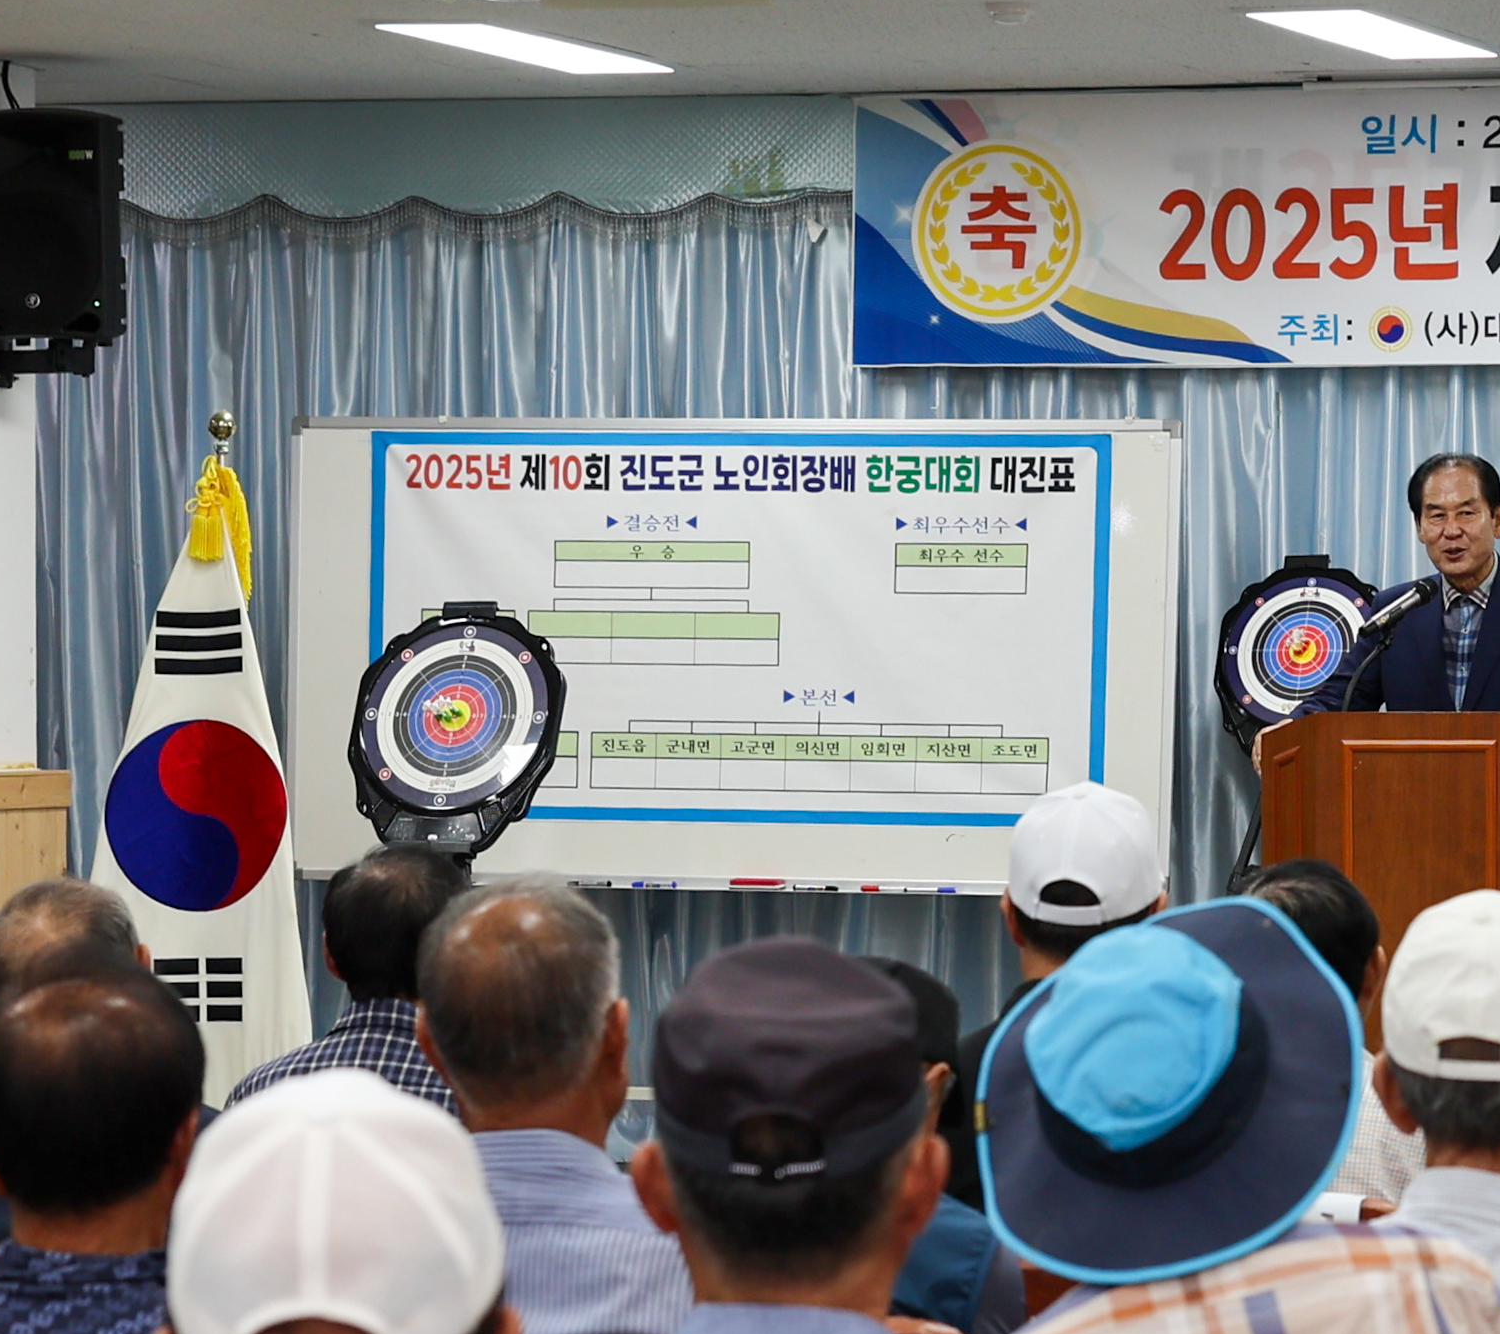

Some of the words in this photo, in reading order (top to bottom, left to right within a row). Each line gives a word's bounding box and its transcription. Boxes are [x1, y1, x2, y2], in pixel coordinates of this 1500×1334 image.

[1361, 114, 1438, 154] 일시
[961, 185, 1037, 269] 축
[1158, 181, 1459, 281] 2025년
[405, 453, 511, 491] 2025년
[519, 452, 610, 492] 제10회
[619, 454, 704, 492] 진도군
[713, 454, 856, 494] 노인회장배
[865, 454, 980, 494] 한궁대회
[989, 455, 1076, 494] 대진표
[623, 514, 680, 533] 결승전
[912, 515, 1010, 535] 최우수선수
[918, 548, 965, 563] 최우수
[972, 549, 1005, 564] 선수
[801, 688, 837, 707] 본선
[601, 737, 646, 754] 진도읍
[665, 738, 710, 755] 군내면
[730, 739, 775, 756] 고군면
[795, 740, 840, 757] 의신면
[860, 740, 906, 757] 임회면
[926, 741, 972, 758] 지산면
[992, 743, 1038, 759] 조도면
